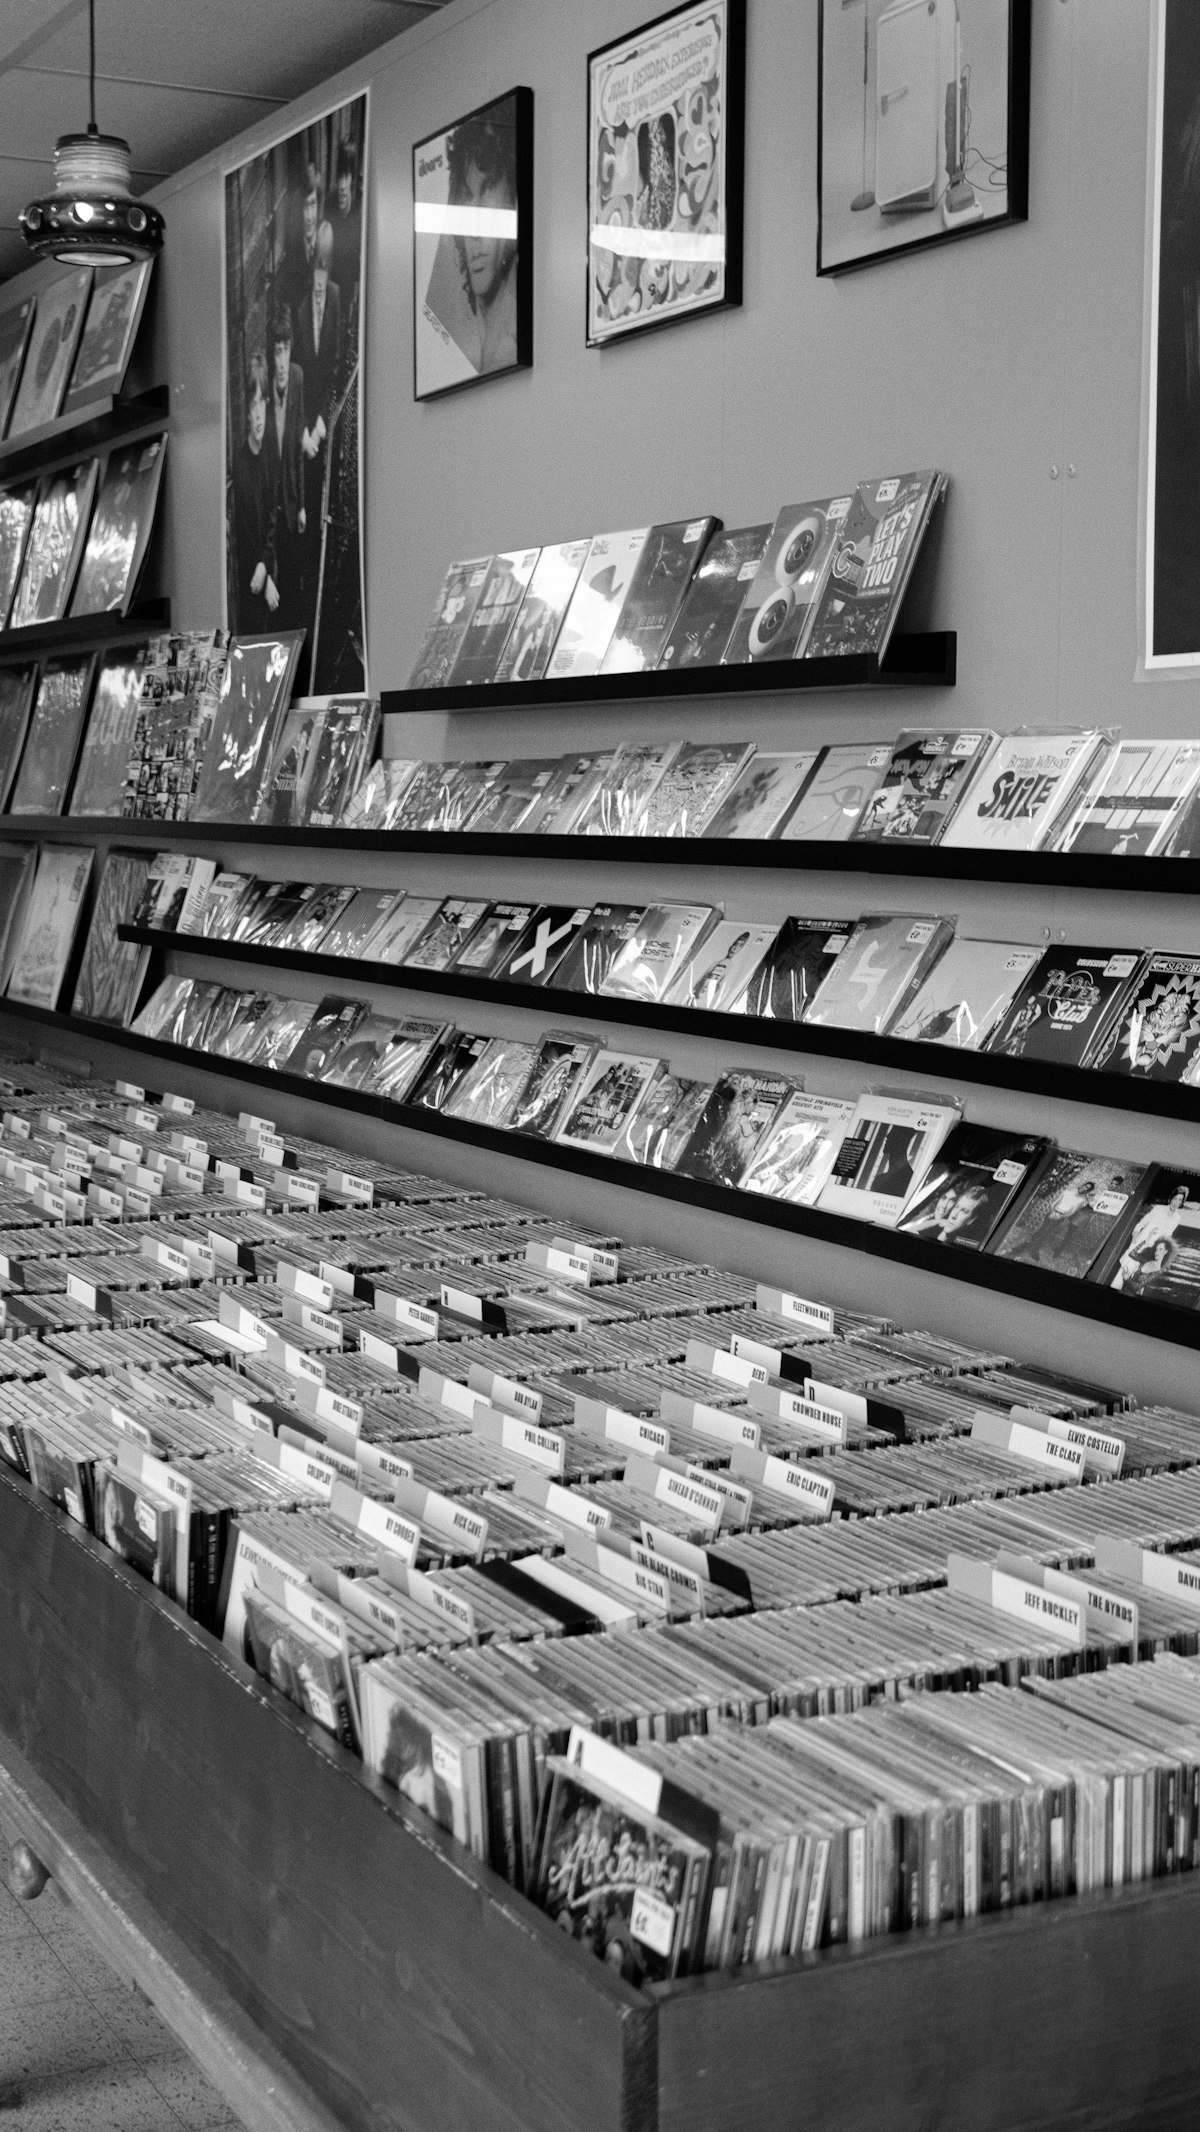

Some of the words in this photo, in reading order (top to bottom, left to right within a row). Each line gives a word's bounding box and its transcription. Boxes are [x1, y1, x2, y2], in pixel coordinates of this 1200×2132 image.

[874, 502, 916, 543] LET'S
[868, 529, 907, 565] PLAY
[862, 556, 898, 589] TWO
[408, 1306, 420, 1320] PETER
[792, 1301, 819, 1319] FLEETWOOD
[818, 1309, 830, 1322] MAC
[514, 1390, 523, 1404] BOB
[523, 1395, 538, 1411] DYLAN
[792, 1400, 822, 1421] CROWDED
[821, 1410, 842, 1429] HOUSE
[524, 1428, 537, 1445] PHIL
[536, 1434, 560, 1454] COLLINS
[639, 1425, 665, 1446] CHICAGO
[742, 1425, 755, 1441] CCR
[1067, 1429, 1086, 1446] ELVIS
[1086, 1435, 1120, 1457] COSTELLO
[378, 1456, 389, 1471] JOE
[1045, 1440, 1060, 1456] THE
[1059, 1444, 1082, 1465] CLASH
[306, 1463, 332, 1486] COLDPLAY
[786, 1469, 801, 1487] ERIC
[800, 1473, 830, 1500] CLAPTON
[667, 1479, 689, 1498] SINEAD
[688, 1485, 719, 1513] O'CONNOR
[392, 1523, 415, 1544] COODER
[454, 1511, 468, 1529] NICK
[467, 1520, 482, 1539] CAVE
[635, 1573, 648, 1589] BIG
[637, 1549, 649, 1567] THE
[649, 1556, 670, 1578] BLACK
[670, 1567, 698, 1593] CROWES
[1024, 1591, 1041, 1610] JEFF
[1041, 1599, 1079, 1626] BUCKLEY
[1087, 1591, 1103, 1608] THE
[1104, 1598, 1133, 1624] BYRDS
